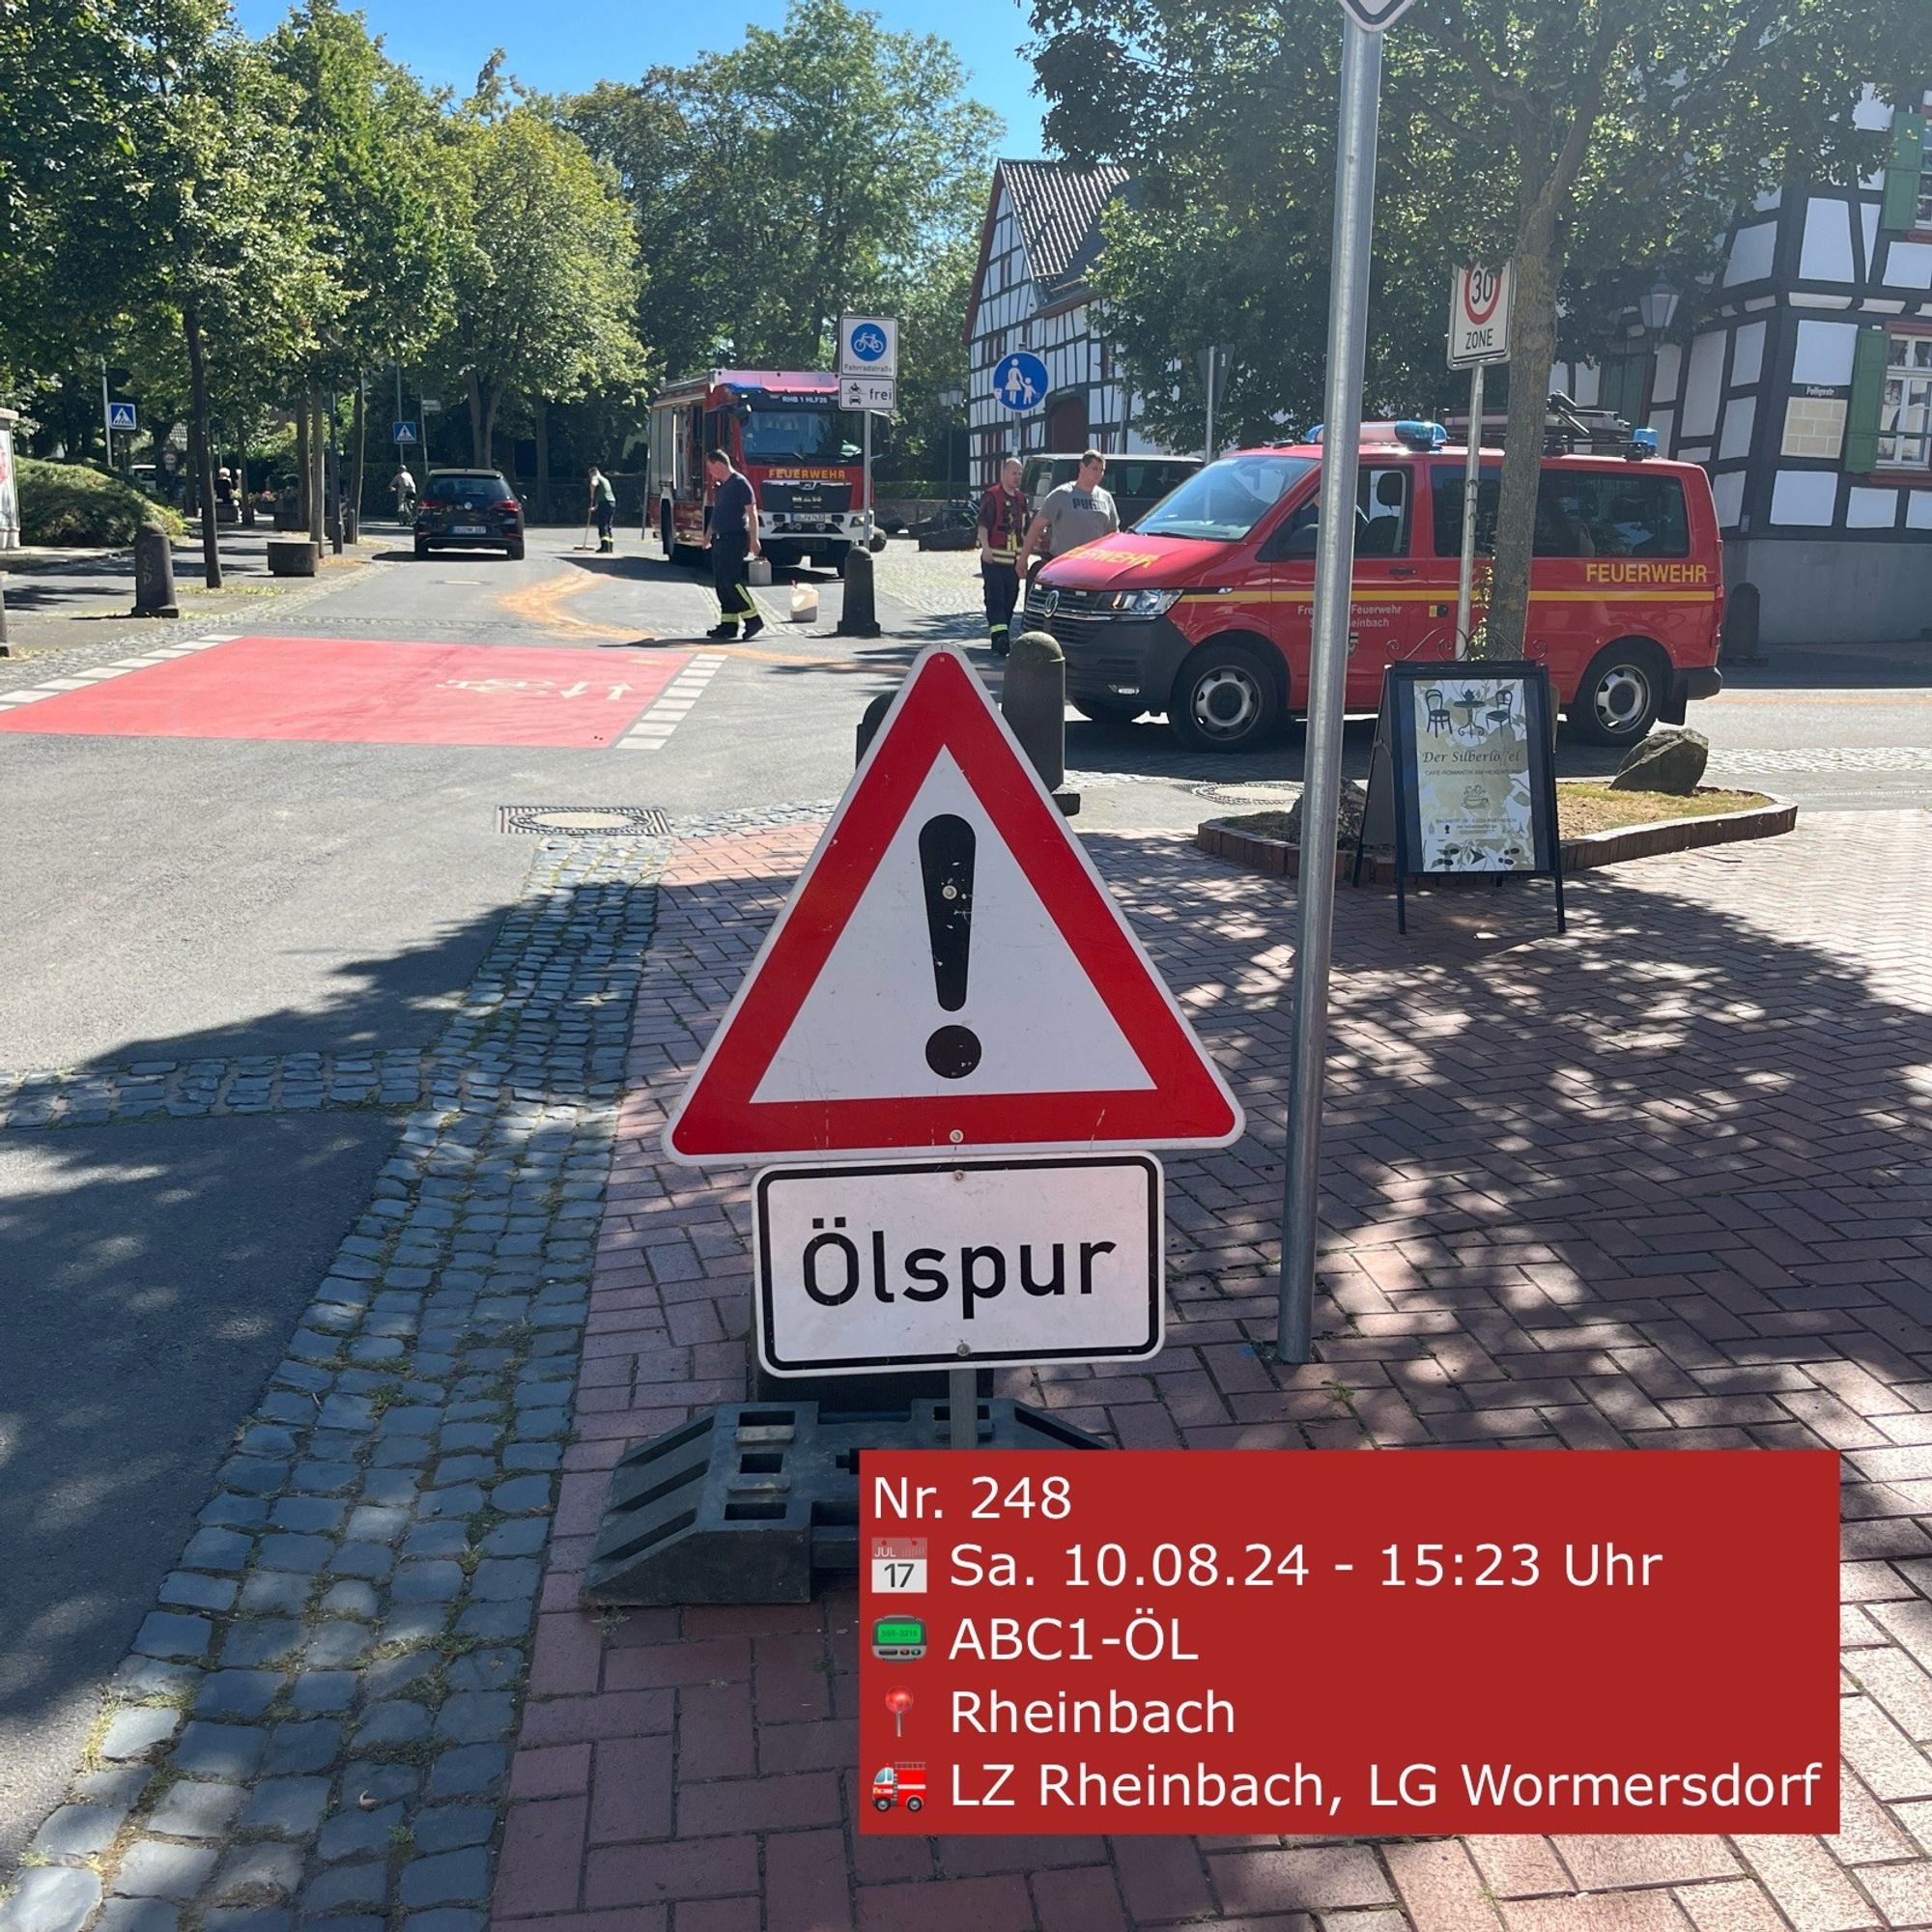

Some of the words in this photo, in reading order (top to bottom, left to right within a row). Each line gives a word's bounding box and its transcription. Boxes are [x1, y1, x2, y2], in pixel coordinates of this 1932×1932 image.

[1471, 270, 1493, 304] 30
[1465, 328, 1493, 350] ZONE
[844, 363, 893, 373] Fahrradstraße
[869, 388, 892, 400] frei
[768, 469, 846, 480] FEUERWEHR
[1586, 563, 1708, 583] FEUERWEHR
[1351, 605, 1402, 615] Feuerwehr
[1351, 618, 1390, 628] einbach
[1423, 752, 1449, 763] Der
[803, 1216, 1118, 1320] Ölspur
